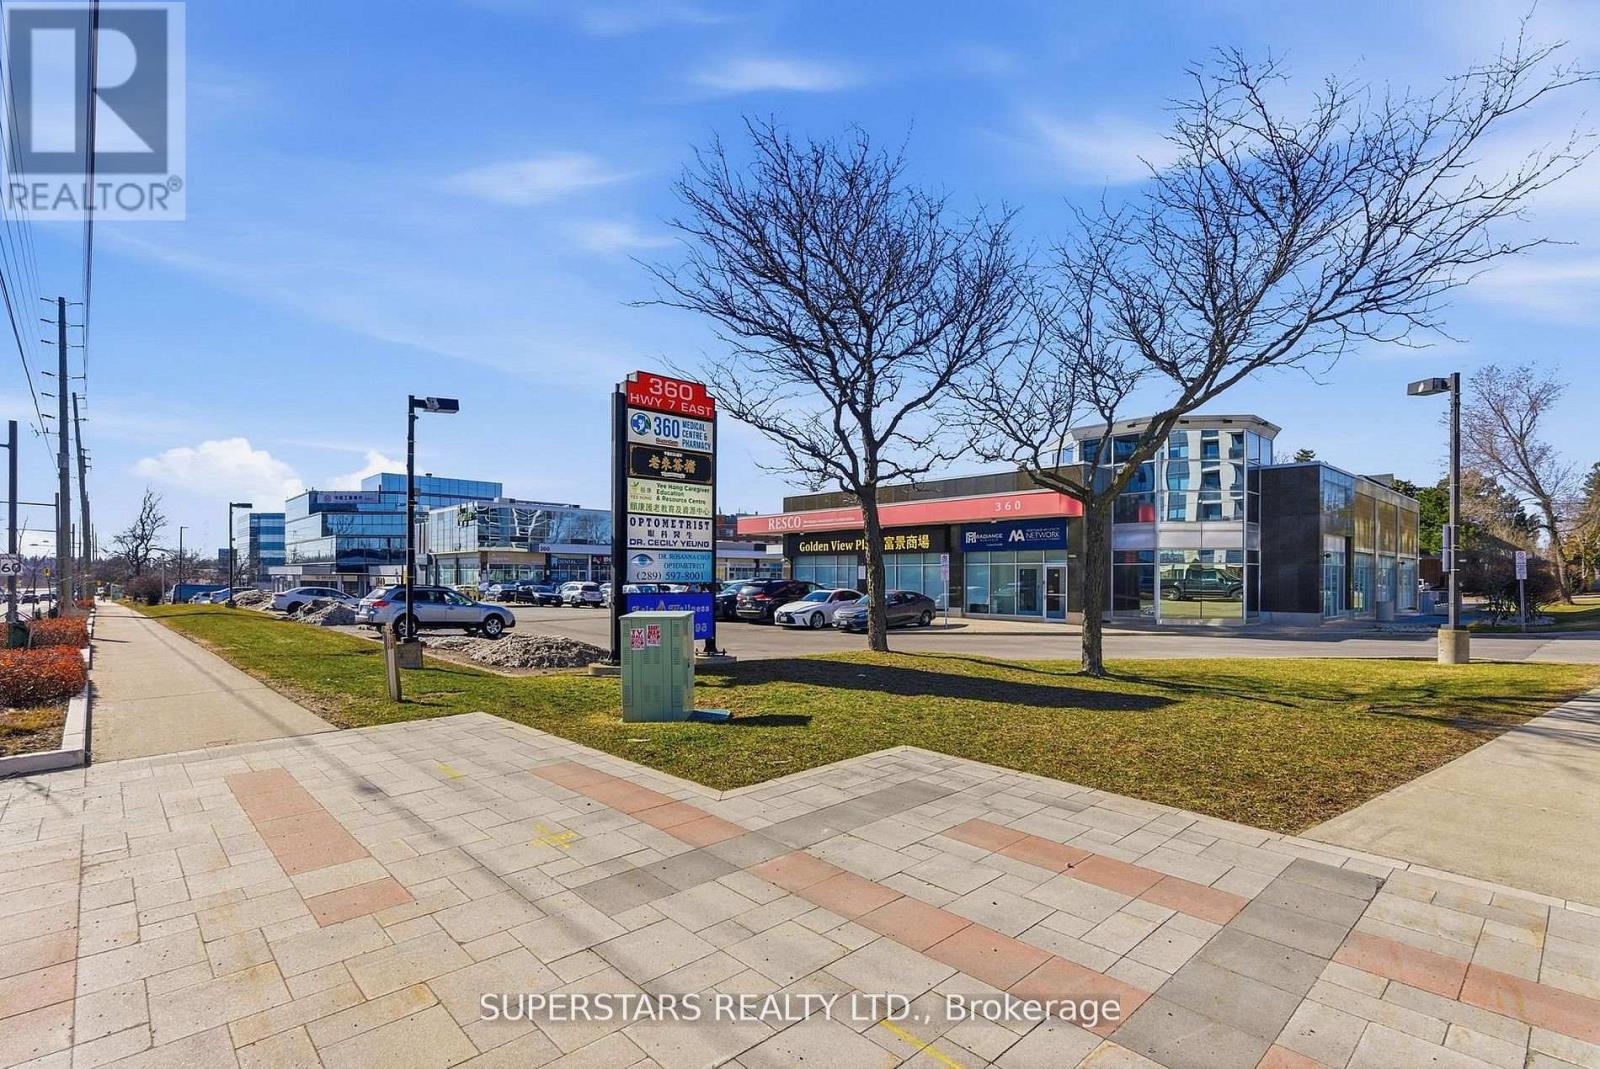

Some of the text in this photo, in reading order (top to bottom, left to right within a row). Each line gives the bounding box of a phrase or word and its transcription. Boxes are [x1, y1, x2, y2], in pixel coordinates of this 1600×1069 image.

[649, 378, 693, 401] 360
[630, 393, 712, 416] HWY 7 EAST
[653, 416, 680, 439] 360
[682, 421, 705, 431] MEDICAL
[682, 429, 702, 440] CENTRE
[682, 439, 711, 450] PHARMACY
[656, 489, 684, 497] Education
[684, 485, 710, 494] Caregiver
[995, 500, 1022, 512] 360
[629, 517, 710, 530] OPTOMETRIST
[768, 516, 801, 530] RESCO
[1026, 530, 1060, 539] NETWORK
[629, 538, 710, 548] DR. CECILY YEUNG
[799, 541, 829, 552] Golden
[831, 539, 853, 550] View
[883, 534, 930, 550] 富景商場
[1, 563, 21, 573] 60
[663, 562, 705, 570] OPTOMETRIST
[636, 571, 704, 581] (289) 597-8001
